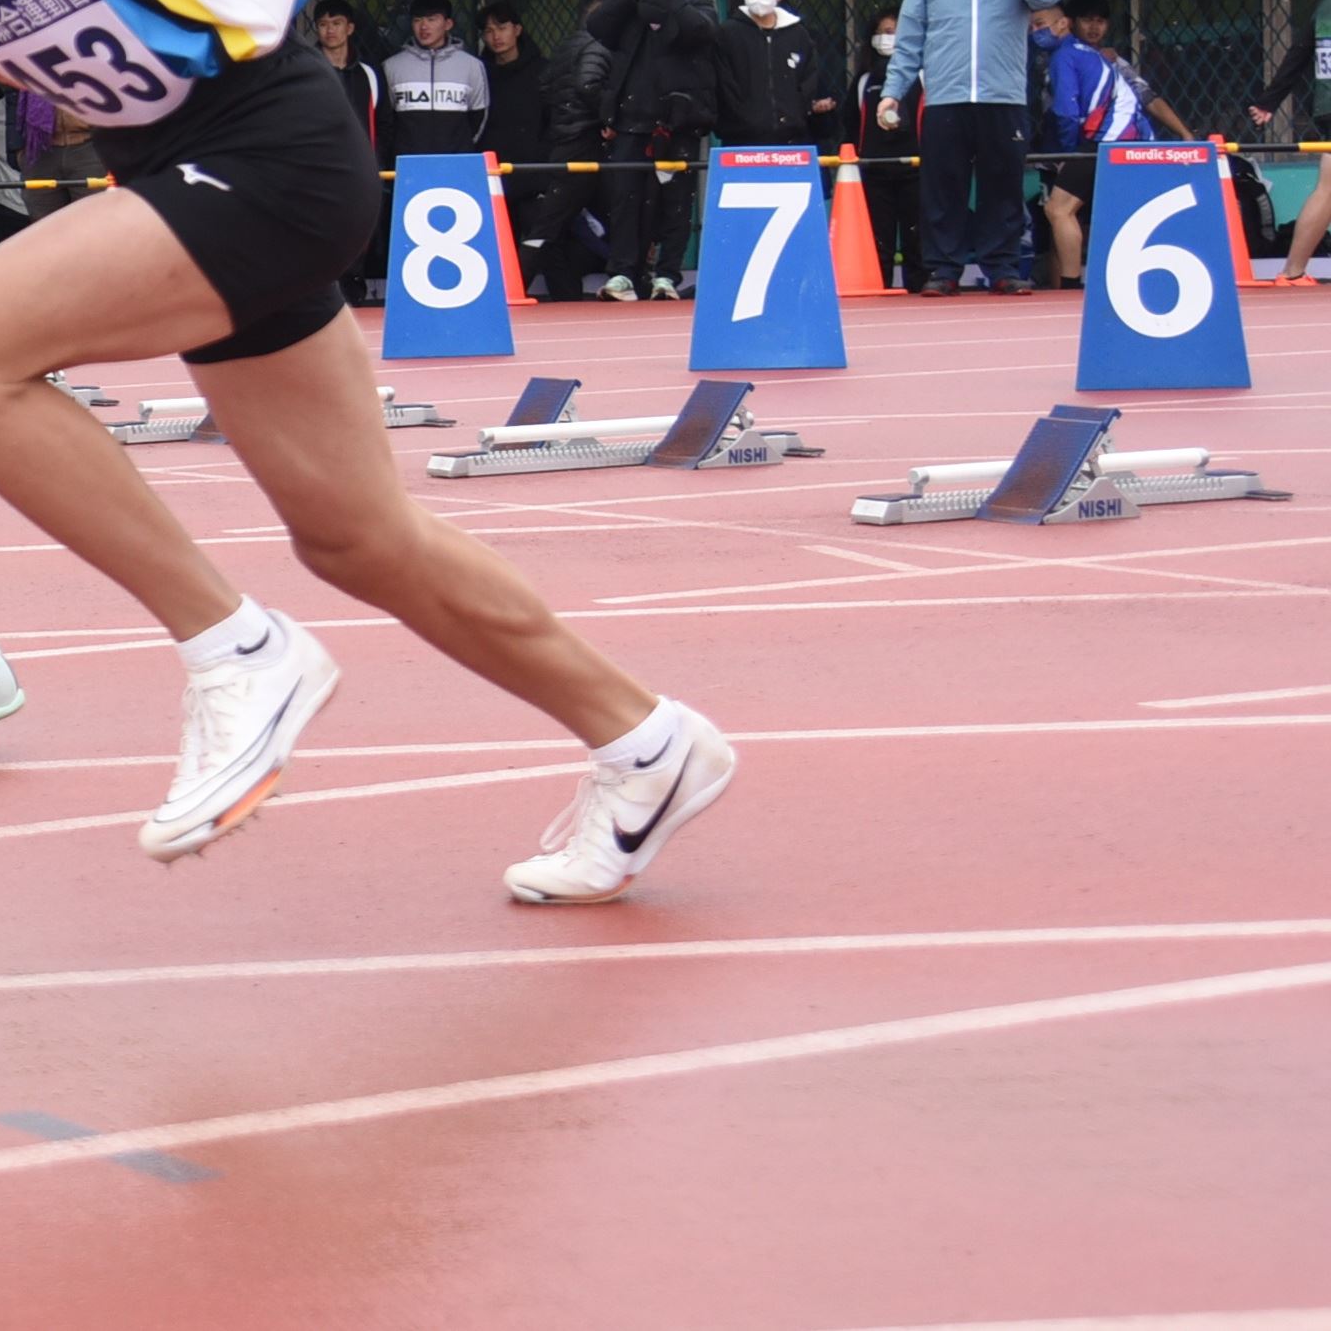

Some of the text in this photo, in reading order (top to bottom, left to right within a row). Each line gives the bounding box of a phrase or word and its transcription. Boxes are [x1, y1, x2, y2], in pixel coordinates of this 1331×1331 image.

[395, 90, 430, 103] FILA
[771, 152, 802, 165] Sport
[1165, 149, 1199, 162] Sport
[401, 187, 488, 308] 8
[718, 182, 812, 322] 7
[1105, 183, 1213, 337] 6
[728, 447, 768, 464] NISHI
[1078, 498, 1122, 518] NISHI
